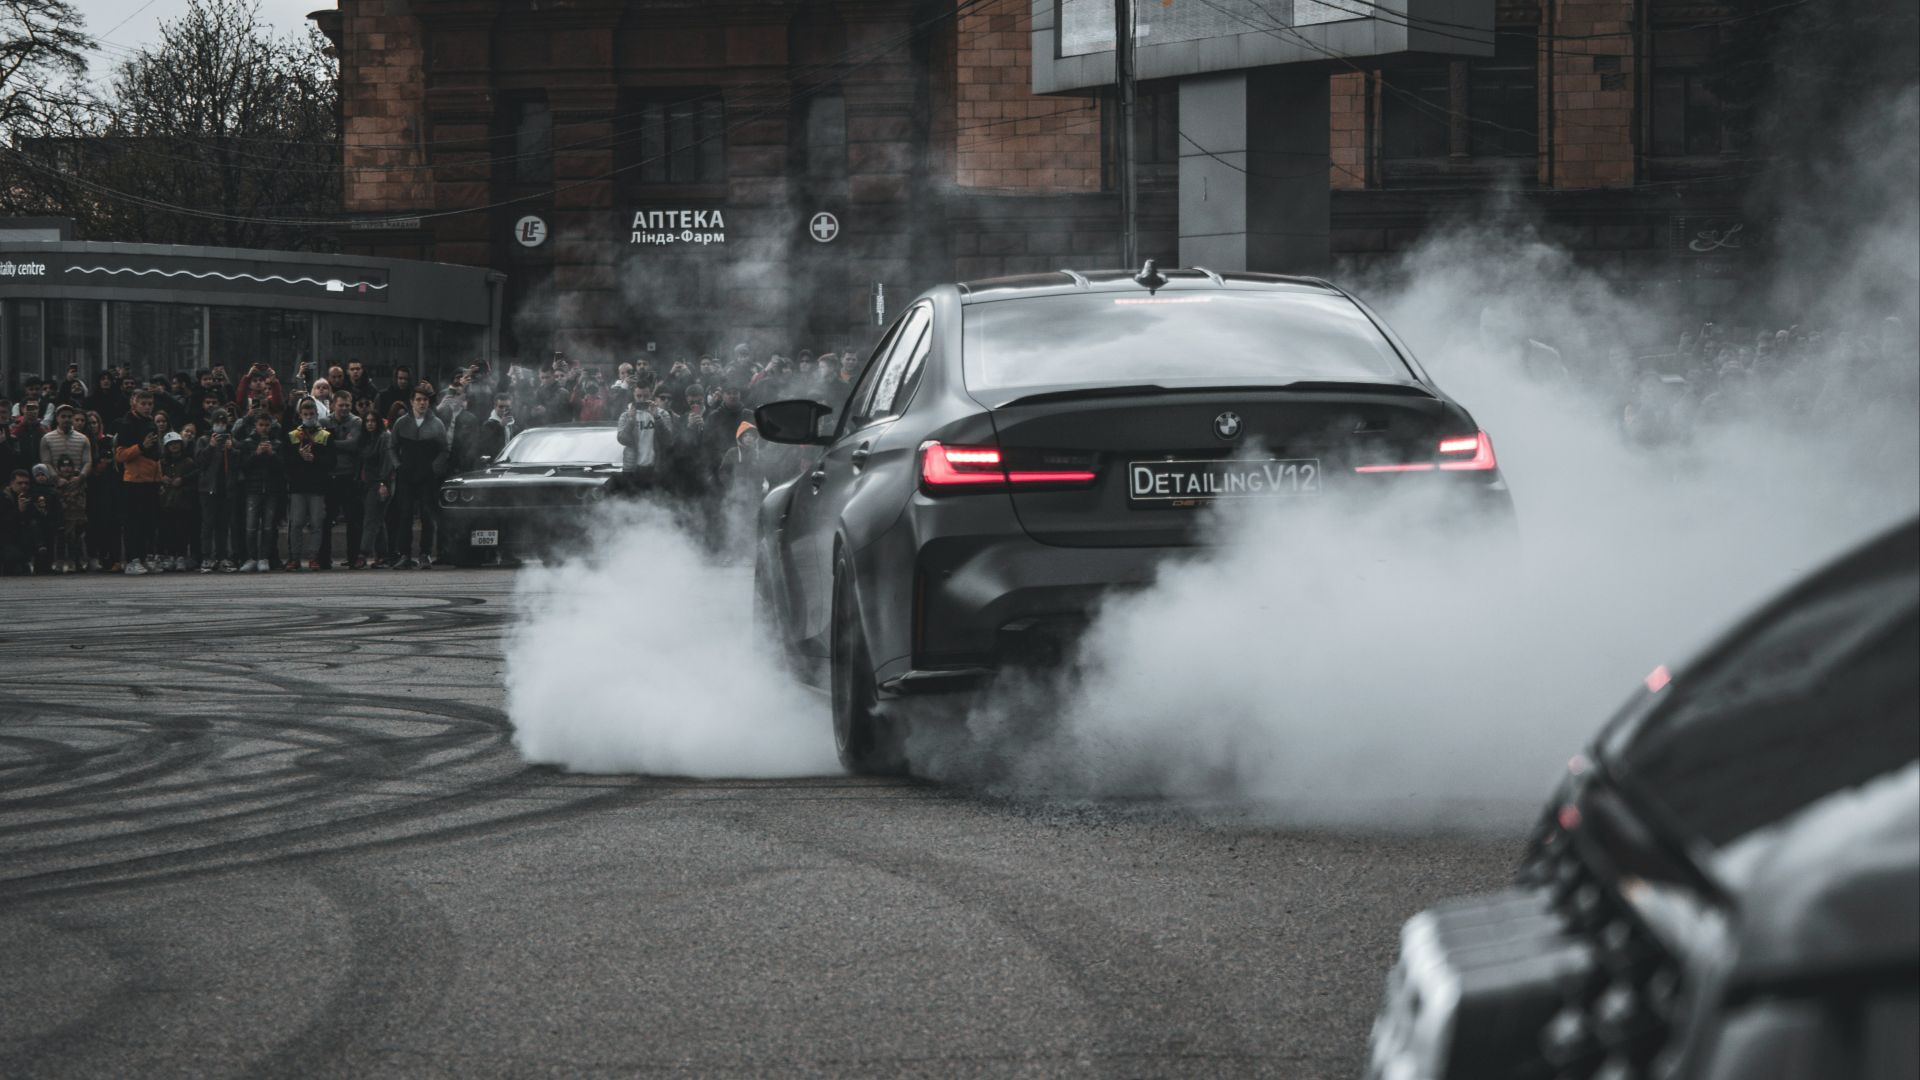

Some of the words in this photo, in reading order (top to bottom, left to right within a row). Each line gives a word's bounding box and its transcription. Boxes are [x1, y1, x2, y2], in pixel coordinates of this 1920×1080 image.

[632, 210, 725, 229] АПТЕКА
[630, 229, 725, 246] Лінда-Фарм
[17, 261, 46, 276] centre
